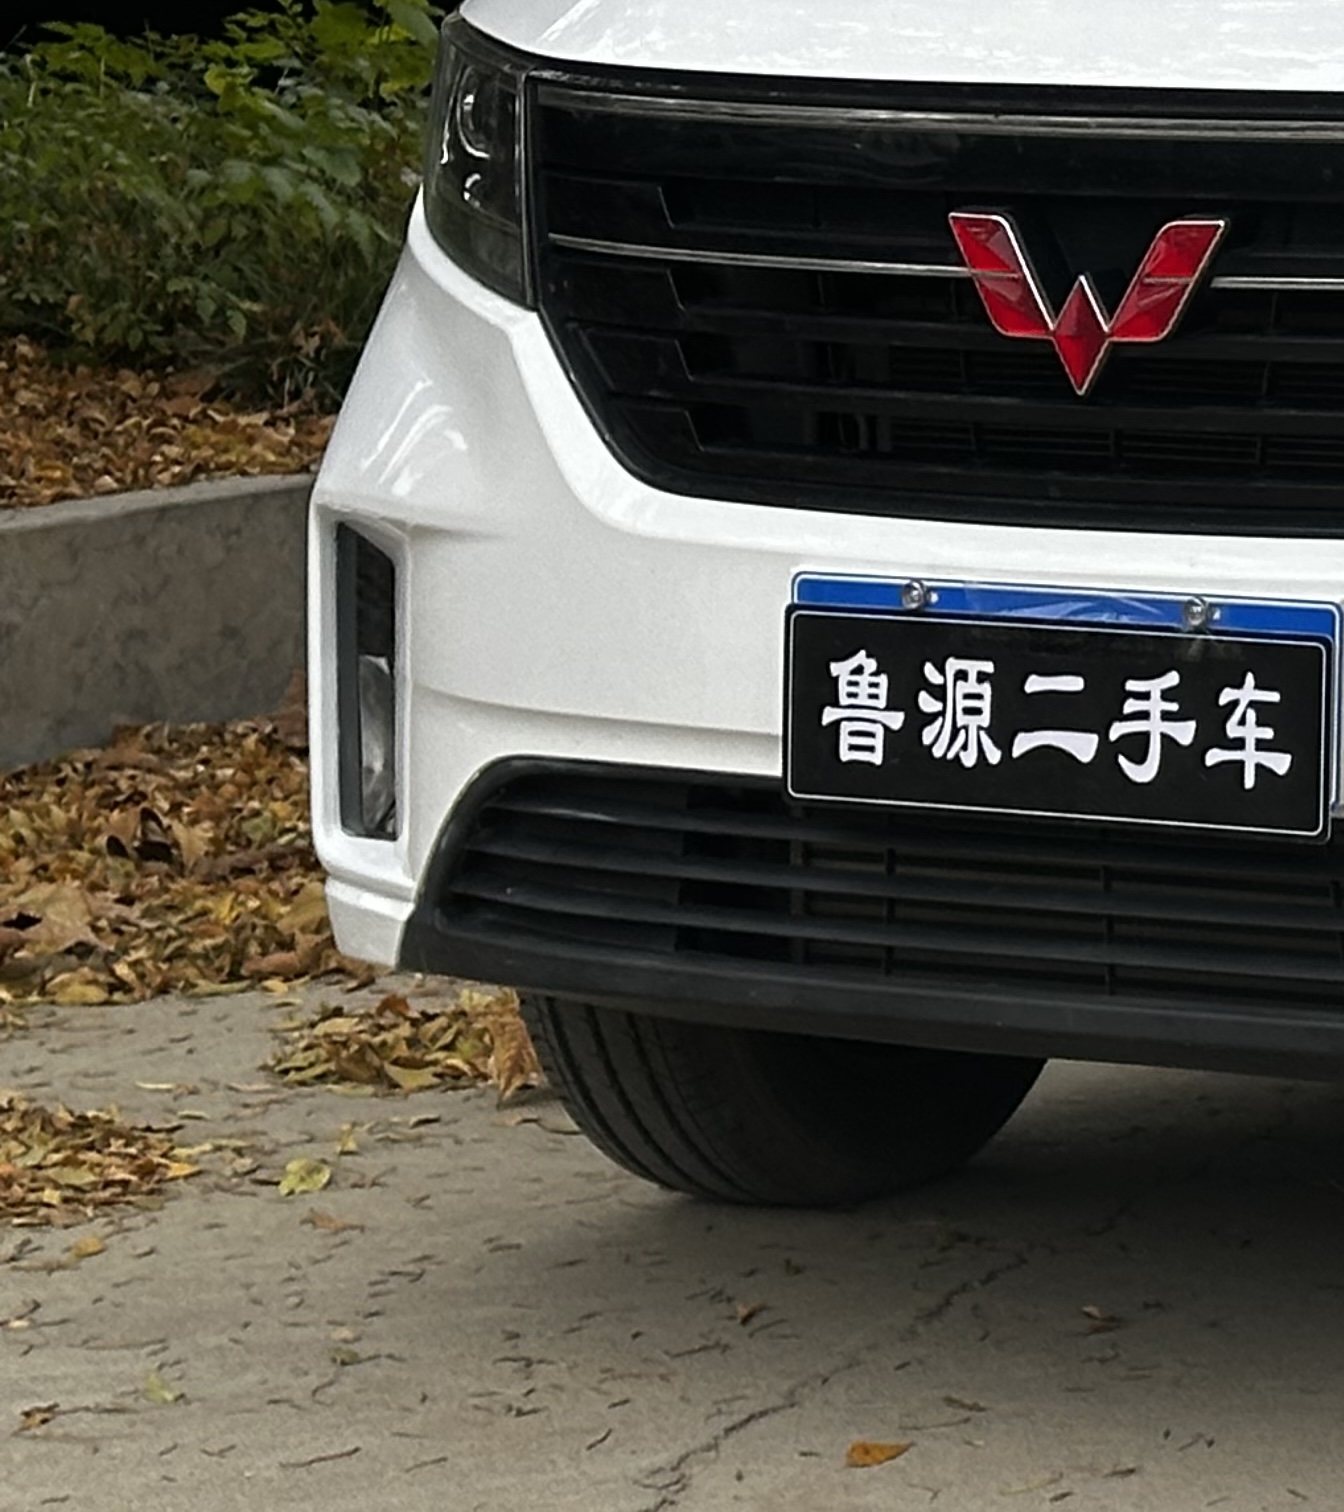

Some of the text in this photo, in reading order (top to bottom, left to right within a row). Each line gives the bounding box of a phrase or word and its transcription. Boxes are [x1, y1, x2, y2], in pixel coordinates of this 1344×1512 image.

[820, 648, 1293, 791] 鲁源二手车
